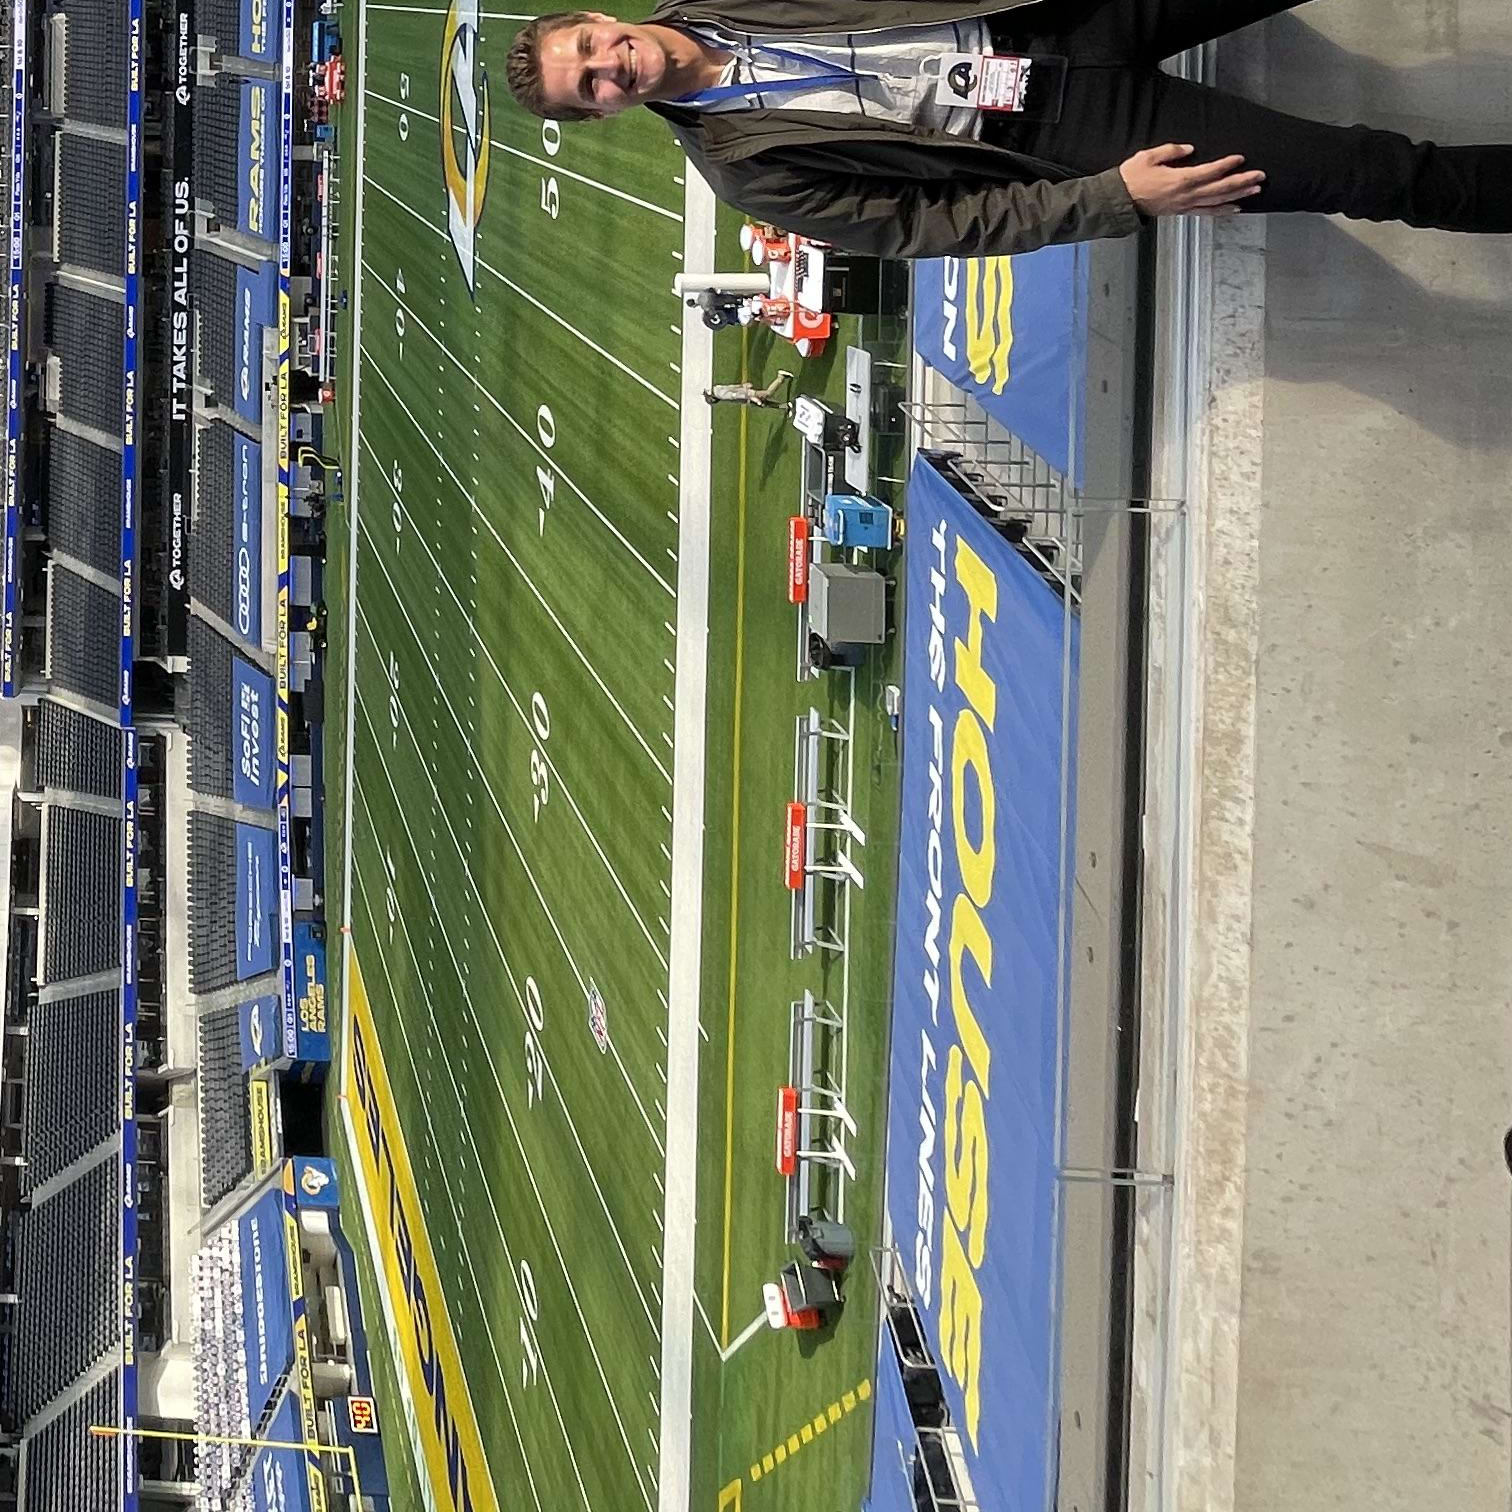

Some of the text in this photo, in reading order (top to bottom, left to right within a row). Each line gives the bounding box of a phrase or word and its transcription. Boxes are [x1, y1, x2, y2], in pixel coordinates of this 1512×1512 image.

[178, 13, 188, 84] TOGETHER
[250, 86, 261, 232] RAMS
[540, 119, 561, 219] 50
[172, 176, 189, 568] TOGETHER IT TAKES ALL OF US.
[242, 288, 251, 365] RAMS
[280, 372, 287, 389] LA
[536, 403, 557, 514] 40
[795, 538, 803, 584] GATORADE
[240, 714, 251, 778] SoFi
[248, 690, 260, 786] Invest
[278, 716, 286, 746] RAMS
[530, 692, 550, 805] 30
[790, 826, 801, 871] GATORADE
[916, 518, 948, 1309] THE FRONT LINES
[306, 955, 317, 1032] ANGELES
[316, 984, 326, 1032] RAMS
[523, 975, 544, 1100] 20
[938, 534, 999, 1454] HOUSE
[782, 1112, 794, 1157] GATORADE
[124, 1256, 134, 1365] BUILT FOR LA
[251, 1216, 268, 1385] BRIDGESTONE
[519, 1260, 539, 1385] 10
[296, 1328, 316, 1439] BUILT FOR LA
[352, 1400, 373, 1429] 40
